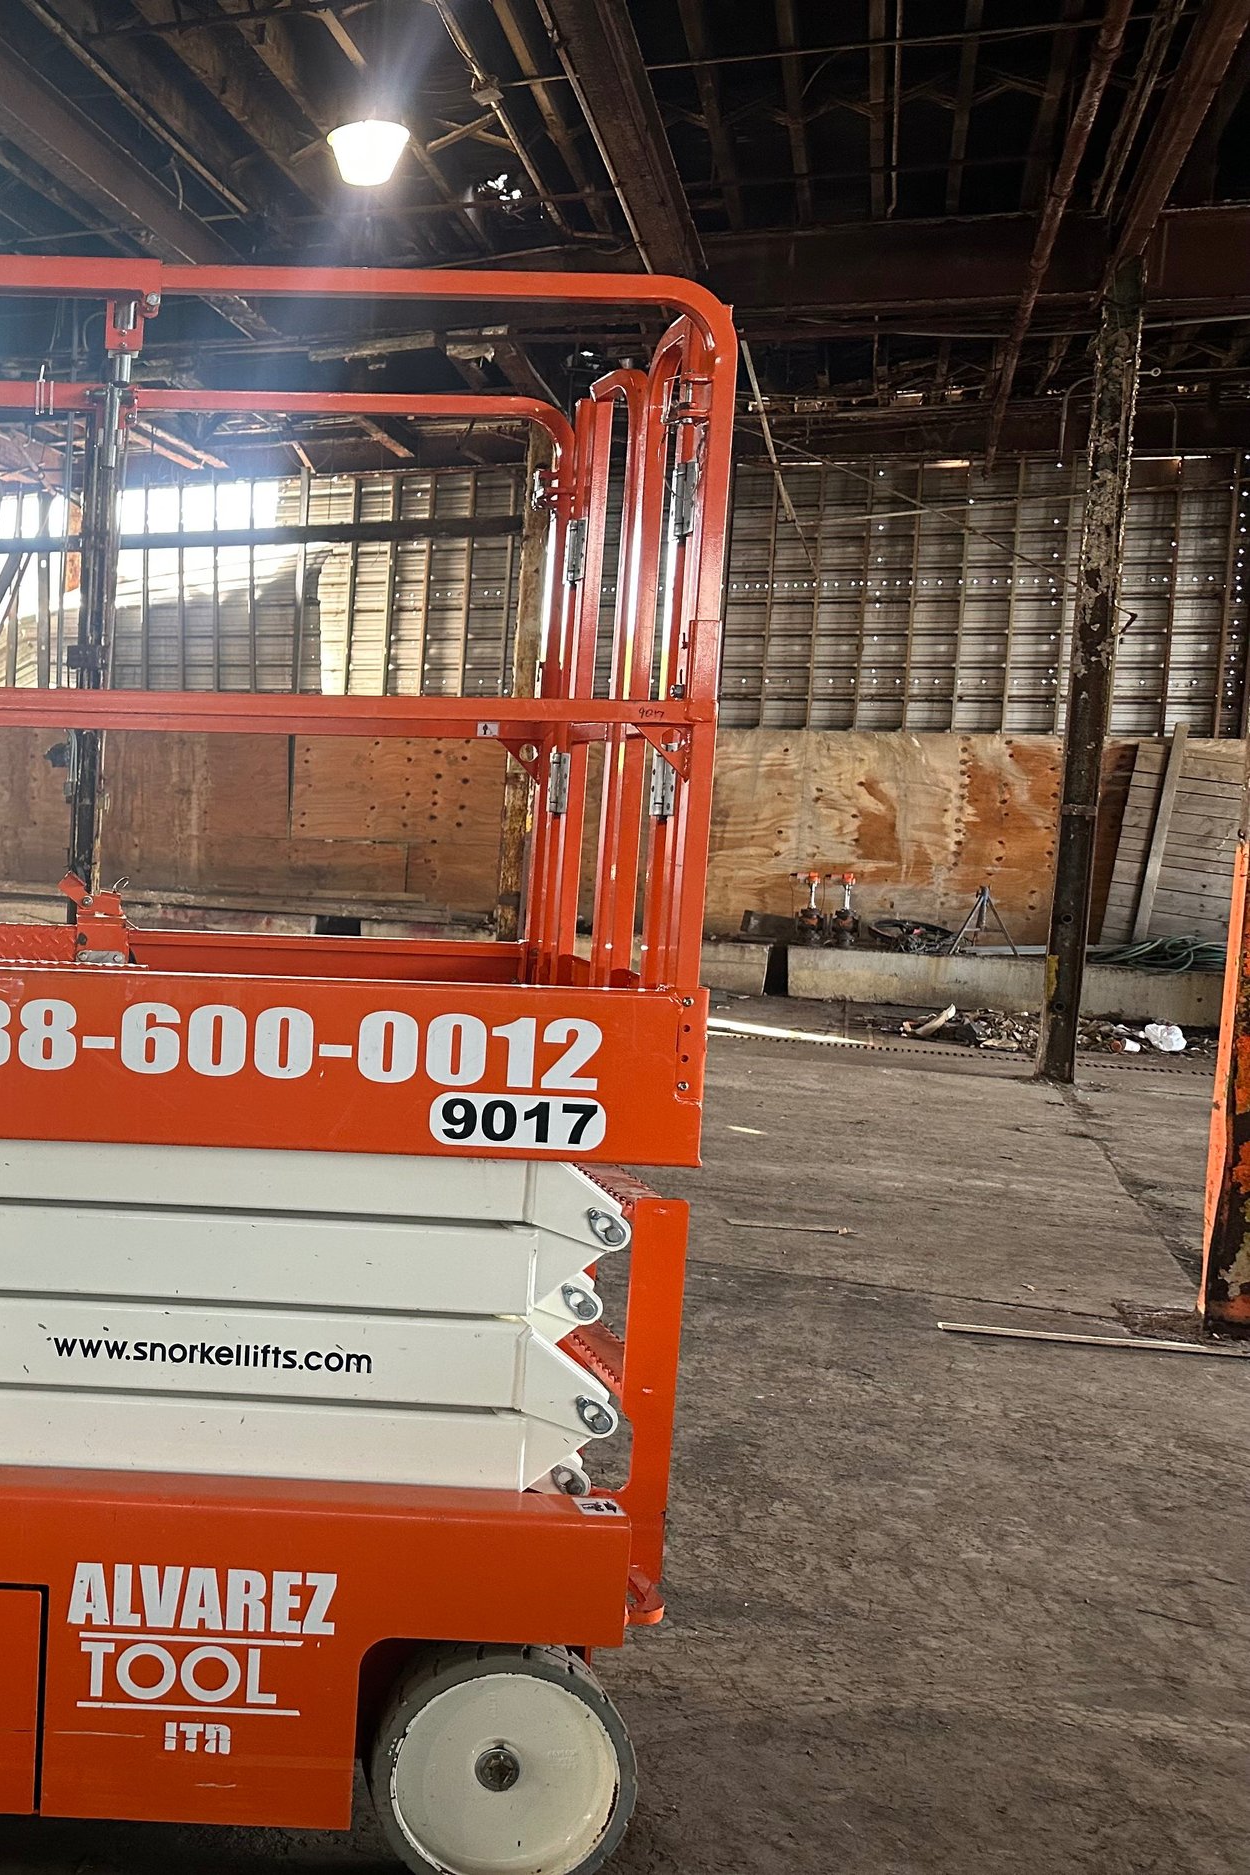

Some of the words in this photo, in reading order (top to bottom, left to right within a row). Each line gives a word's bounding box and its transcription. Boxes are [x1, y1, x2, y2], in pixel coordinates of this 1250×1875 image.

[441, 1098, 598, 1144] 9017
[53, 1337, 372, 1373] www.snorkellifts.com
[67, 1562, 337, 1635] ALVAREZ
[81, 1641, 277, 1704] TOOL
